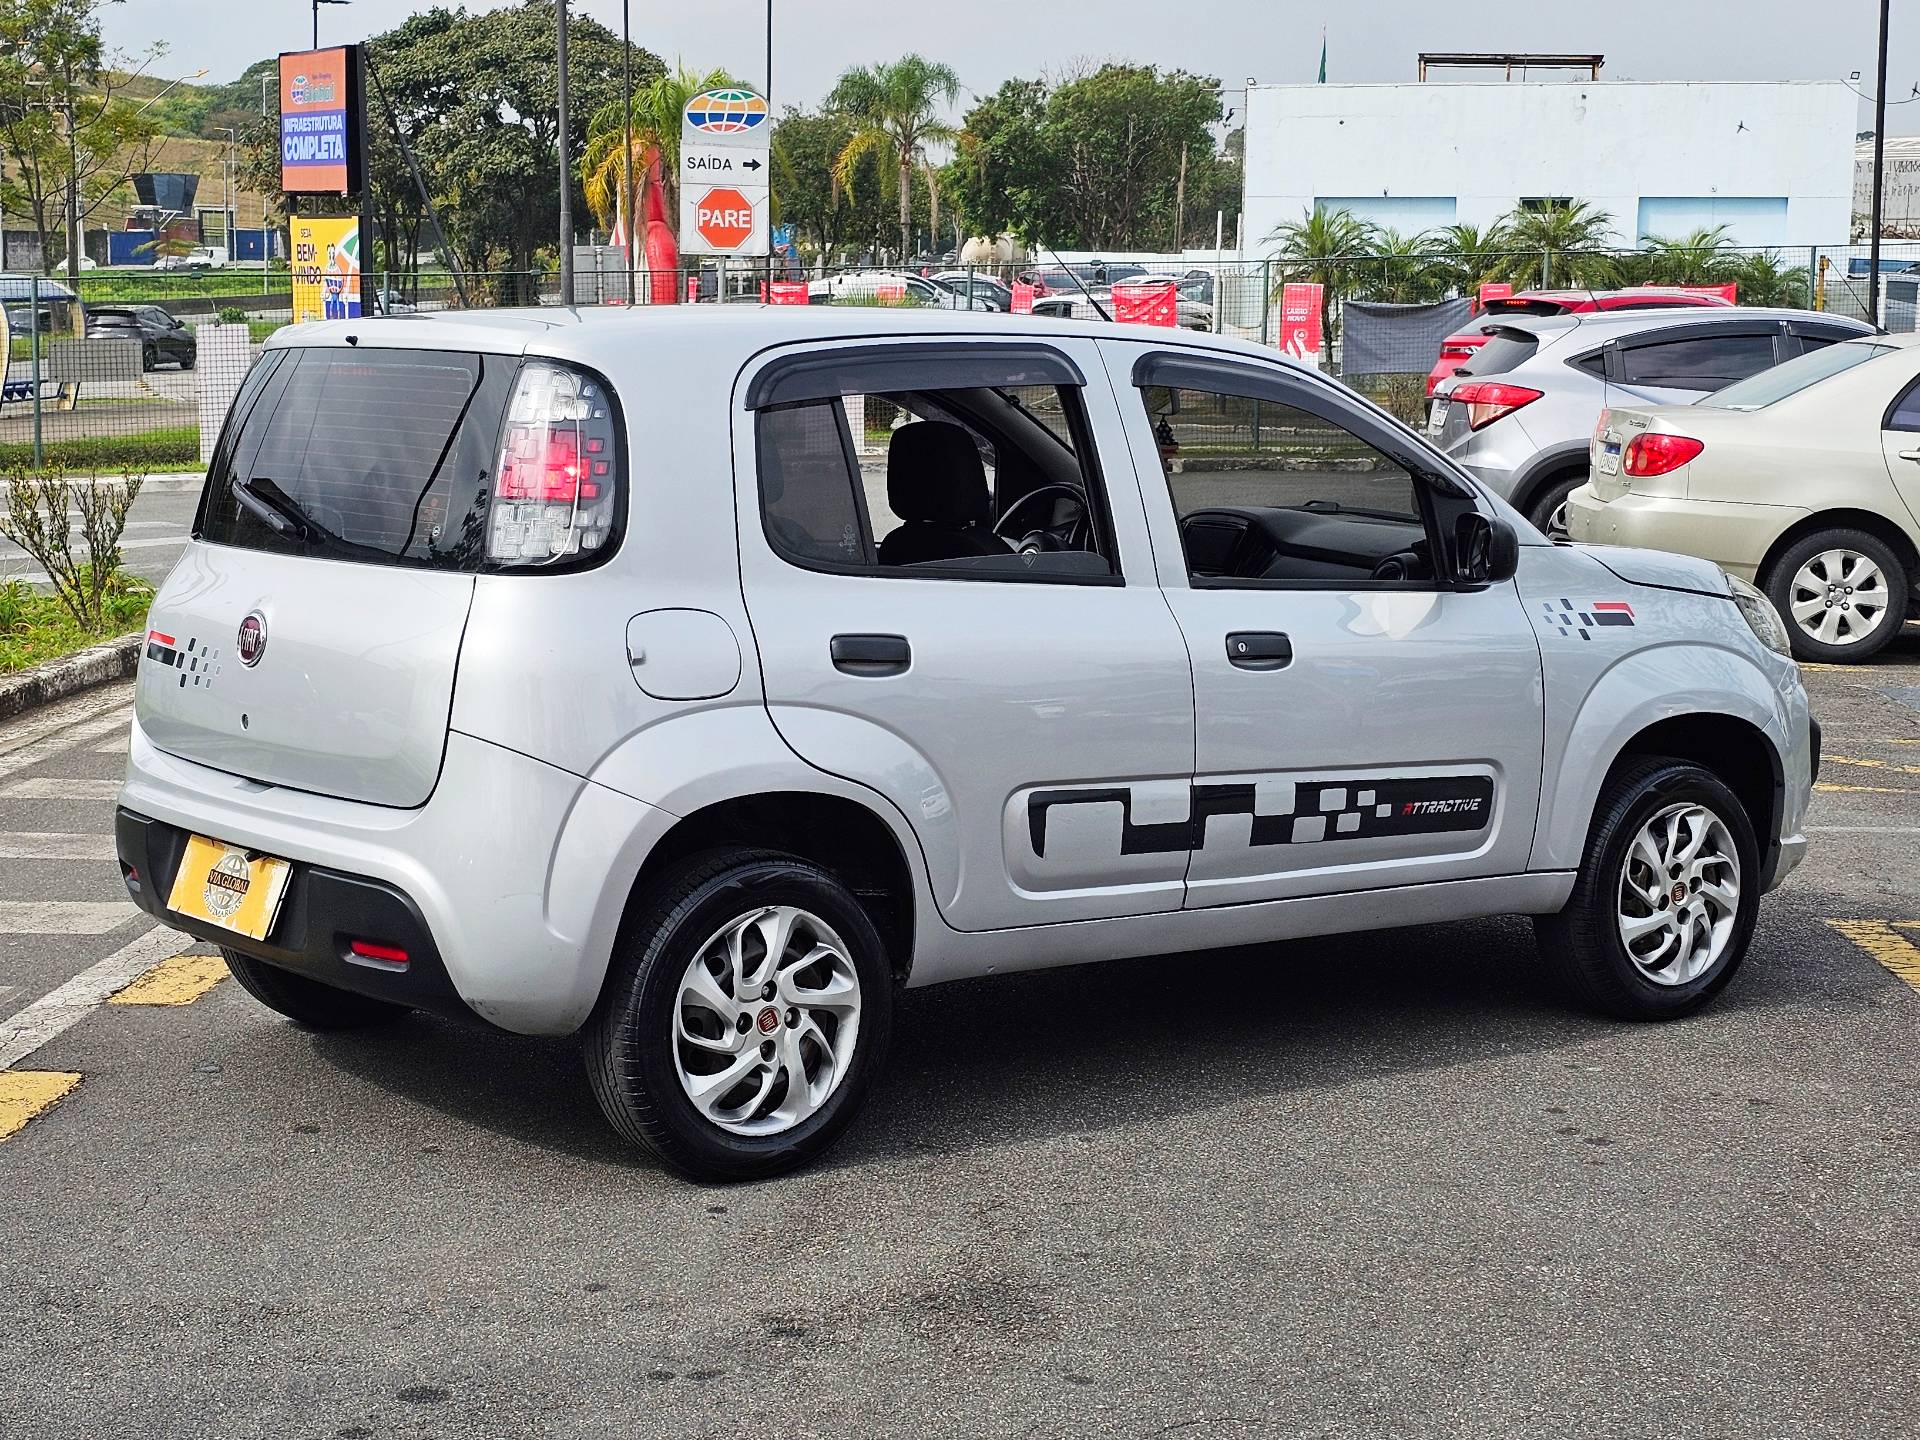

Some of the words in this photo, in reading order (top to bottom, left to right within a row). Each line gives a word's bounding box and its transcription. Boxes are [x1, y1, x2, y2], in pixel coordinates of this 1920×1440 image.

[284, 114, 343, 133] INFRAESTRUTURA
[284, 134, 344, 160] COMPLETA
[687, 153, 733, 171] SAÍDA
[698, 208, 751, 228] PARE
[300, 228, 312, 238] SEJA
[296, 243, 318, 262] BEM-
[294, 265, 322, 285] VINDO
[242, 627, 260, 652] FIAT
[210, 870, 222, 885] VIA
[221, 875, 249, 893] GLOBAL
